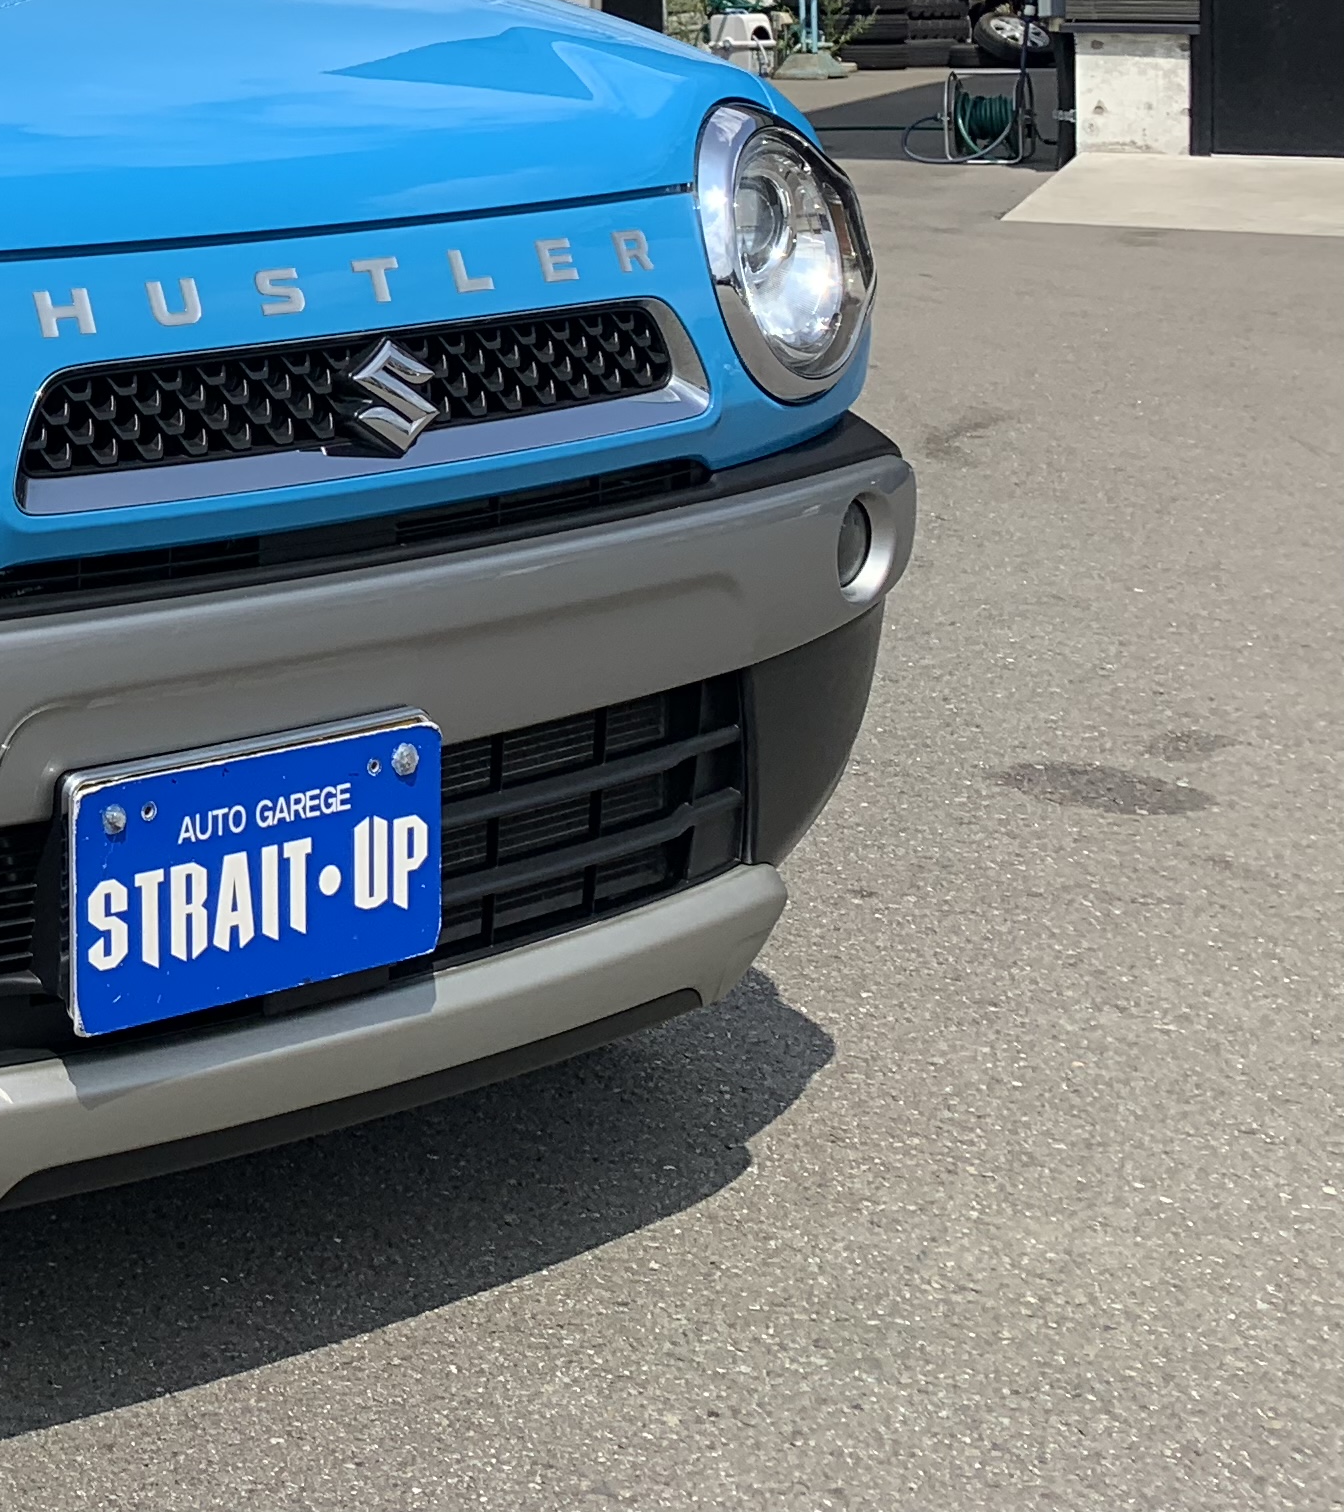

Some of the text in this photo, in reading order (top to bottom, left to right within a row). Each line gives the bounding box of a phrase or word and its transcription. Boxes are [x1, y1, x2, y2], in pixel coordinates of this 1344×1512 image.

[32, 229, 655, 339] HUSTLER
[177, 782, 352, 845] AUTO GAREGE
